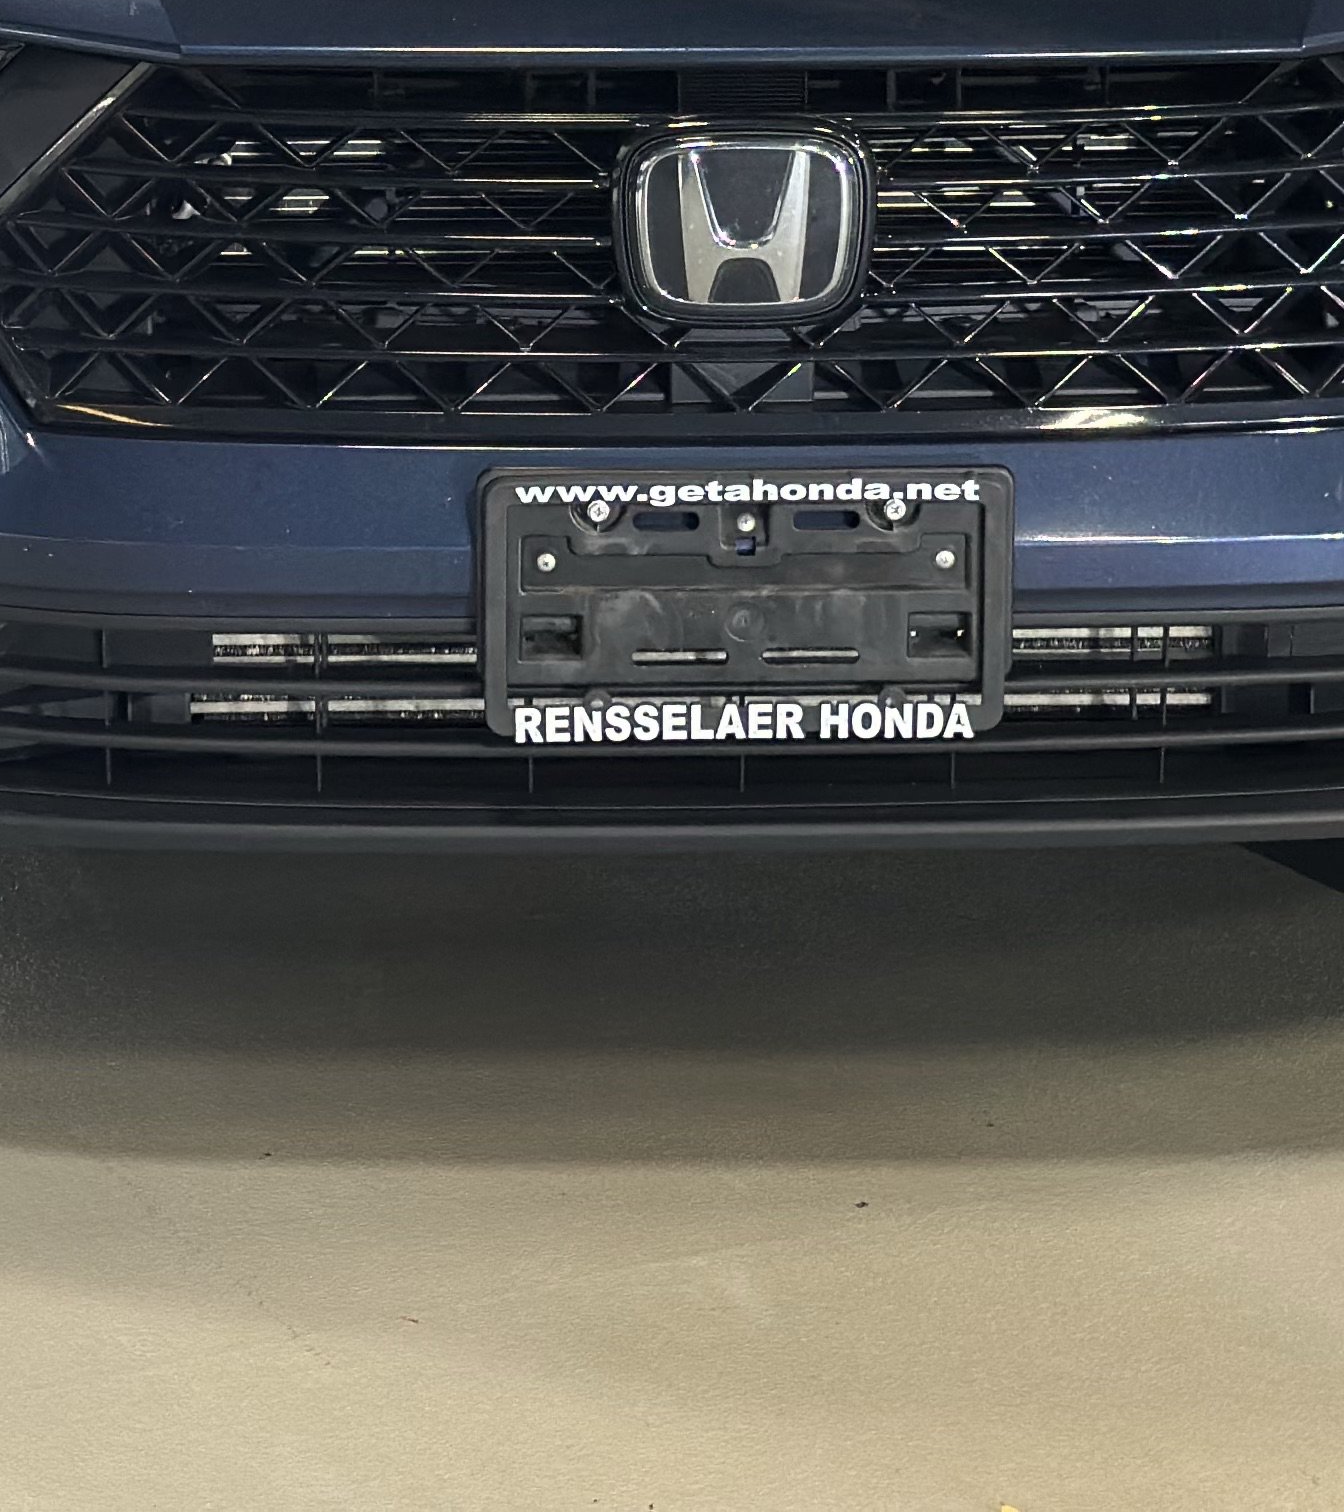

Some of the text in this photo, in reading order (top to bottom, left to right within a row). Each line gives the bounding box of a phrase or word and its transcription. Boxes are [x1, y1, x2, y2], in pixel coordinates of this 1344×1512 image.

[678, 150, 810, 303] H
[514, 478, 981, 506] www.getahonda.net
[514, 703, 975, 744] RENSSELAER HONDA
